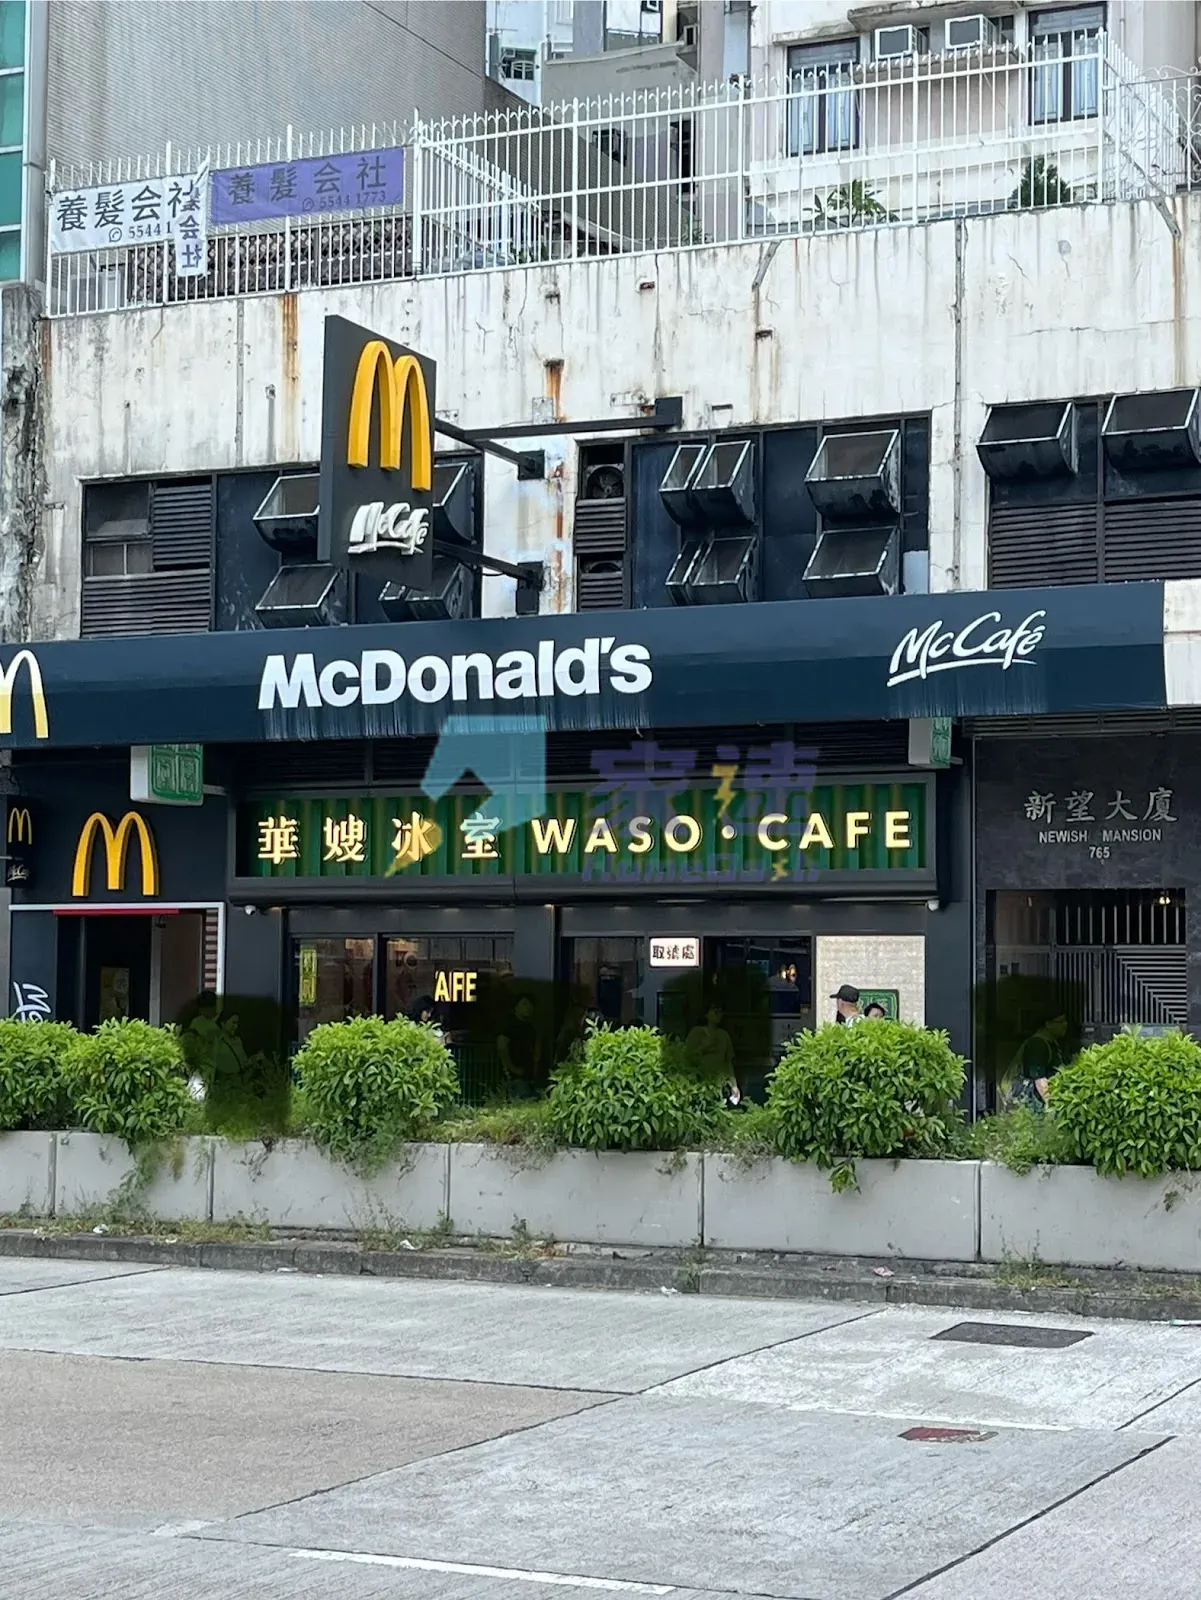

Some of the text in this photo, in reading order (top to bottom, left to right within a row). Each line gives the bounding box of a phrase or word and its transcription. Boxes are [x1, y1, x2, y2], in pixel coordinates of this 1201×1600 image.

[228, 156, 387, 206] 養髮会社
[319, 190, 386, 210] 5544 1773
[128, 222, 161, 238] 5544
[886, 609, 1047, 687] McCafé
[257, 636, 653, 710] McDonald's
[1023, 786, 1179, 824] 新望大廈
[257, 810, 913, 865] 華嫂冰室 WASO CAFE
[1038, 828, 1162, 844] NEWISH MANSION
[1089, 846, 1111, 860] 765
